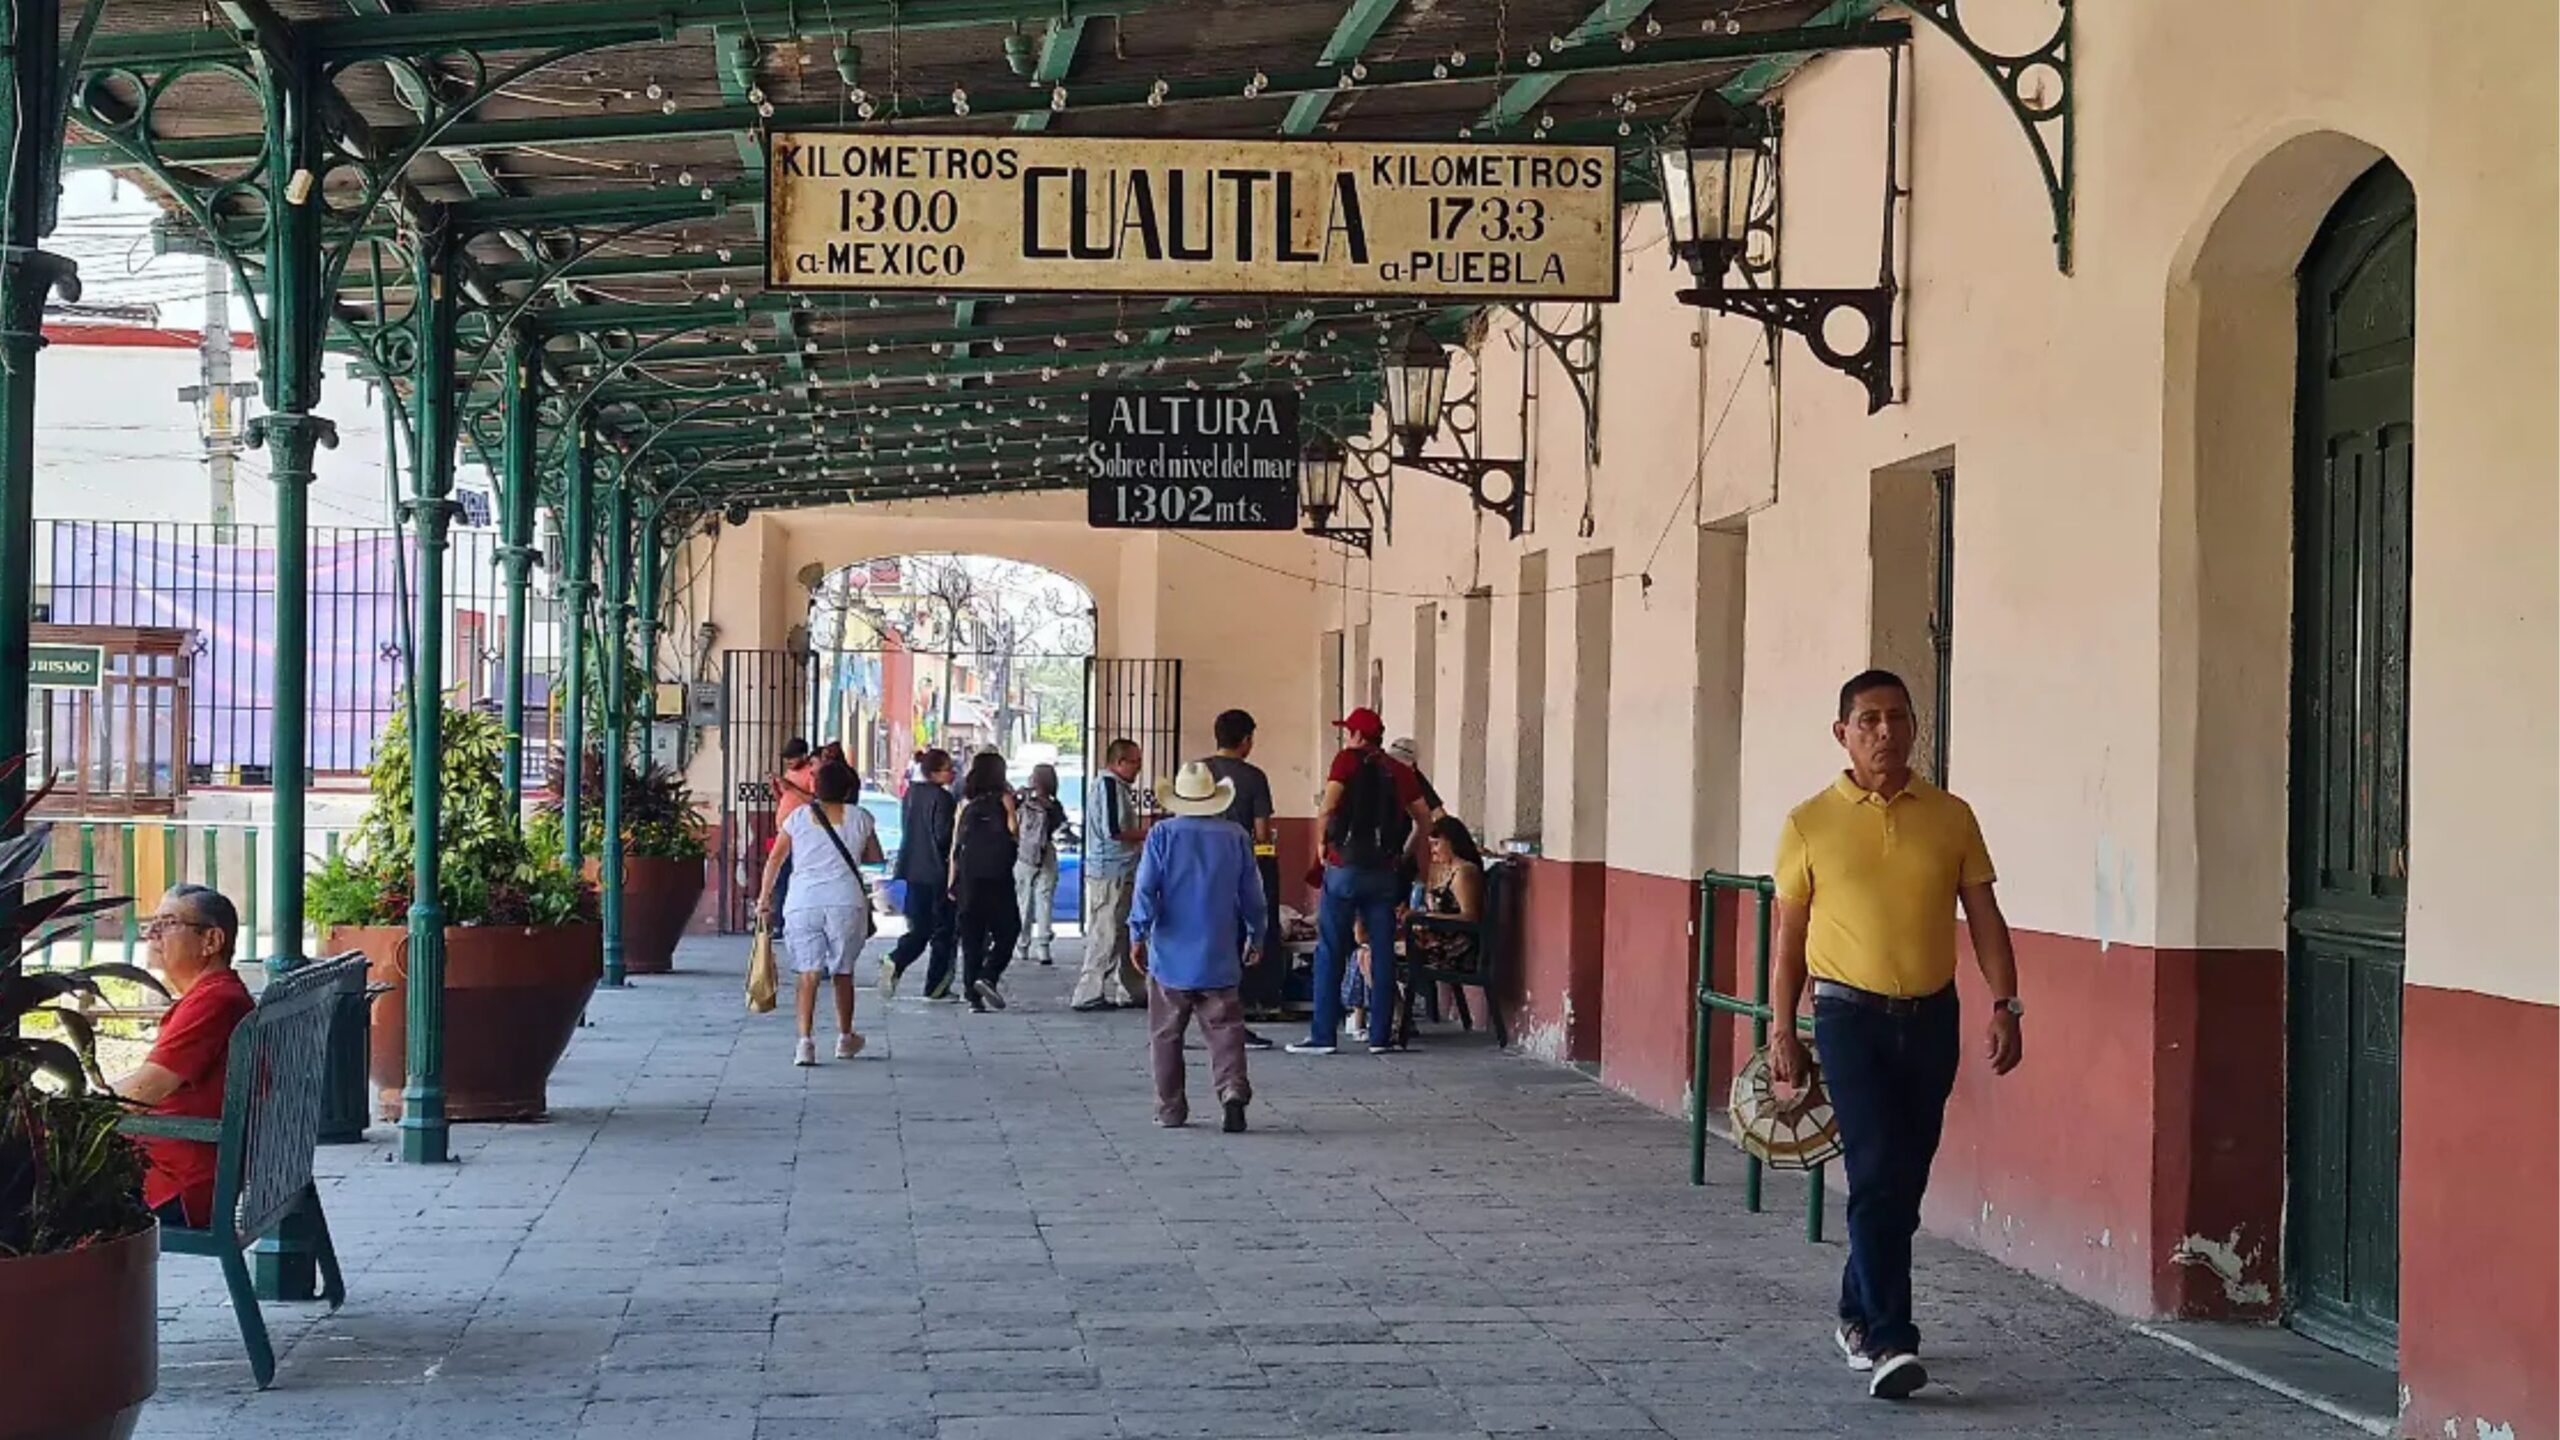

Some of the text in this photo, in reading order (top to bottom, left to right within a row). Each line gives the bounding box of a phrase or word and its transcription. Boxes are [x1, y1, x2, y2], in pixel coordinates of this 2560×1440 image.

[781, 145, 1018, 179] KILOMETROS
[1372, 155, 1602, 189] KILOMETROS
[840, 188, 958, 233] 130.0
[1023, 166, 1370, 265] CUAUTLA
[1429, 197, 1545, 242] 173.3
[1108, 396, 1280, 435] ALTURA
[1088, 440, 1295, 480] Sobre el nivel del mar
[29, 660, 90, 674] URISMO
